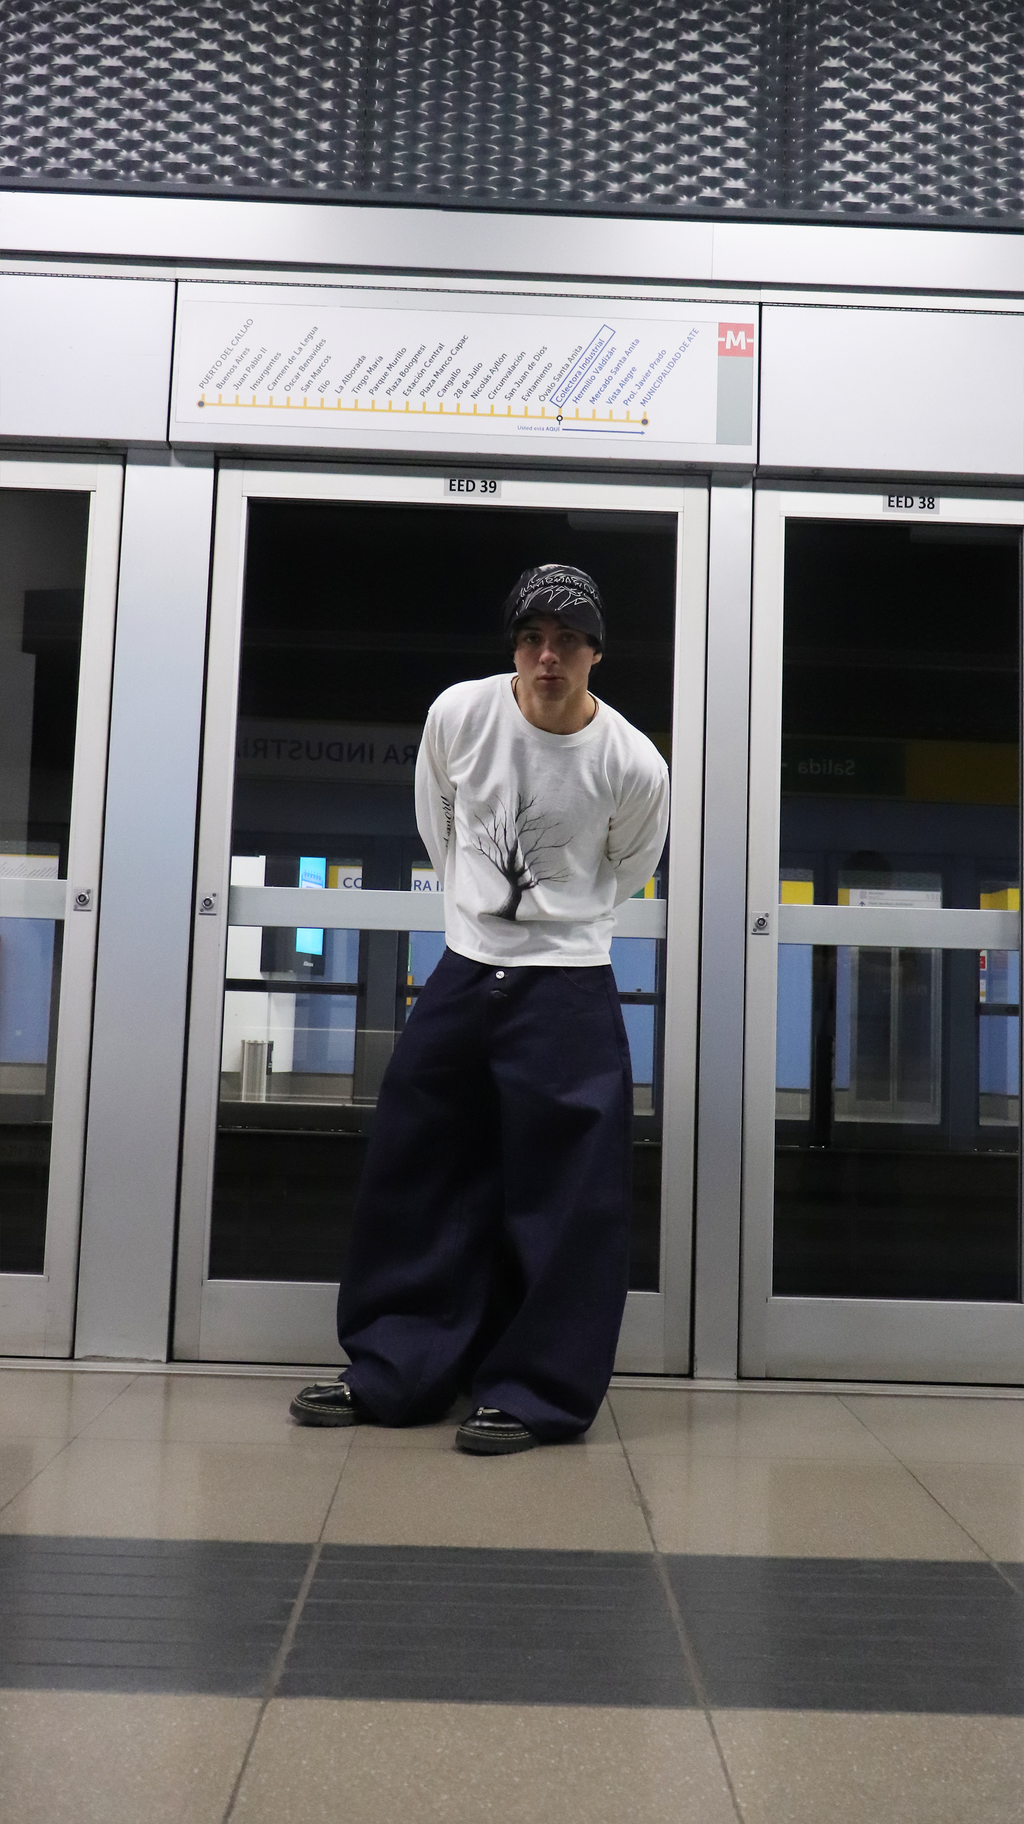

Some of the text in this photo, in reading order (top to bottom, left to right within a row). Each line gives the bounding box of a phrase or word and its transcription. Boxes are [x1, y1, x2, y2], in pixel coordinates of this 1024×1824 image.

[199, 319, 253, 389] PUERTO DEL CALLAO
[267, 326, 318, 391] Carmen de La Legua
[726, 330, 746, 350] M
[216, 347, 250, 390] Buenos Aires
[233, 373, 248, 390] Juan
[246, 353, 262, 373] Pablo
[250, 352, 281, 391] Insurgentes
[284, 339, 326, 392] Oscar Benavides
[300, 355, 331, 393] San Marcos
[318, 380, 330, 393] Elio
[335, 355, 366, 394] La Alborada
[351, 355, 383, 394] Tingo María
[369, 347, 406, 395] Parque Murillo
[386, 344, 426, 396] Plaza Bolognesi
[402, 343, 445, 396] Estación Central
[420, 378, 436, 398] Plaza
[433, 356, 452, 379] Manco
[437, 368, 461, 398] Cangallo
[454, 362, 483, 399] 28 de Julio
[470, 353, 508, 400] Nicolás Ayllón
[488, 351, 526, 400] Circunvalación
[504, 346, 548, 401] San Juan de Dios
[521, 362, 552, 402] Evitamiento
[538, 345, 582, 402] Óvalo Santa Anita
[556, 339, 605, 402] Colectora Industrial
[572, 346, 616, 404] Hermilio Valdizán
[589, 338, 640, 404] Mercado Santa Anita
[606, 366, 637, 405] Vista Alegre
[623, 349, 666, 406] Prol. Javier Prado
[640, 328, 699, 407] MUNICIPALIDAD DE ATE
[449, 479, 497, 493] EED 39
[888, 496, 935, 509] EED 38
